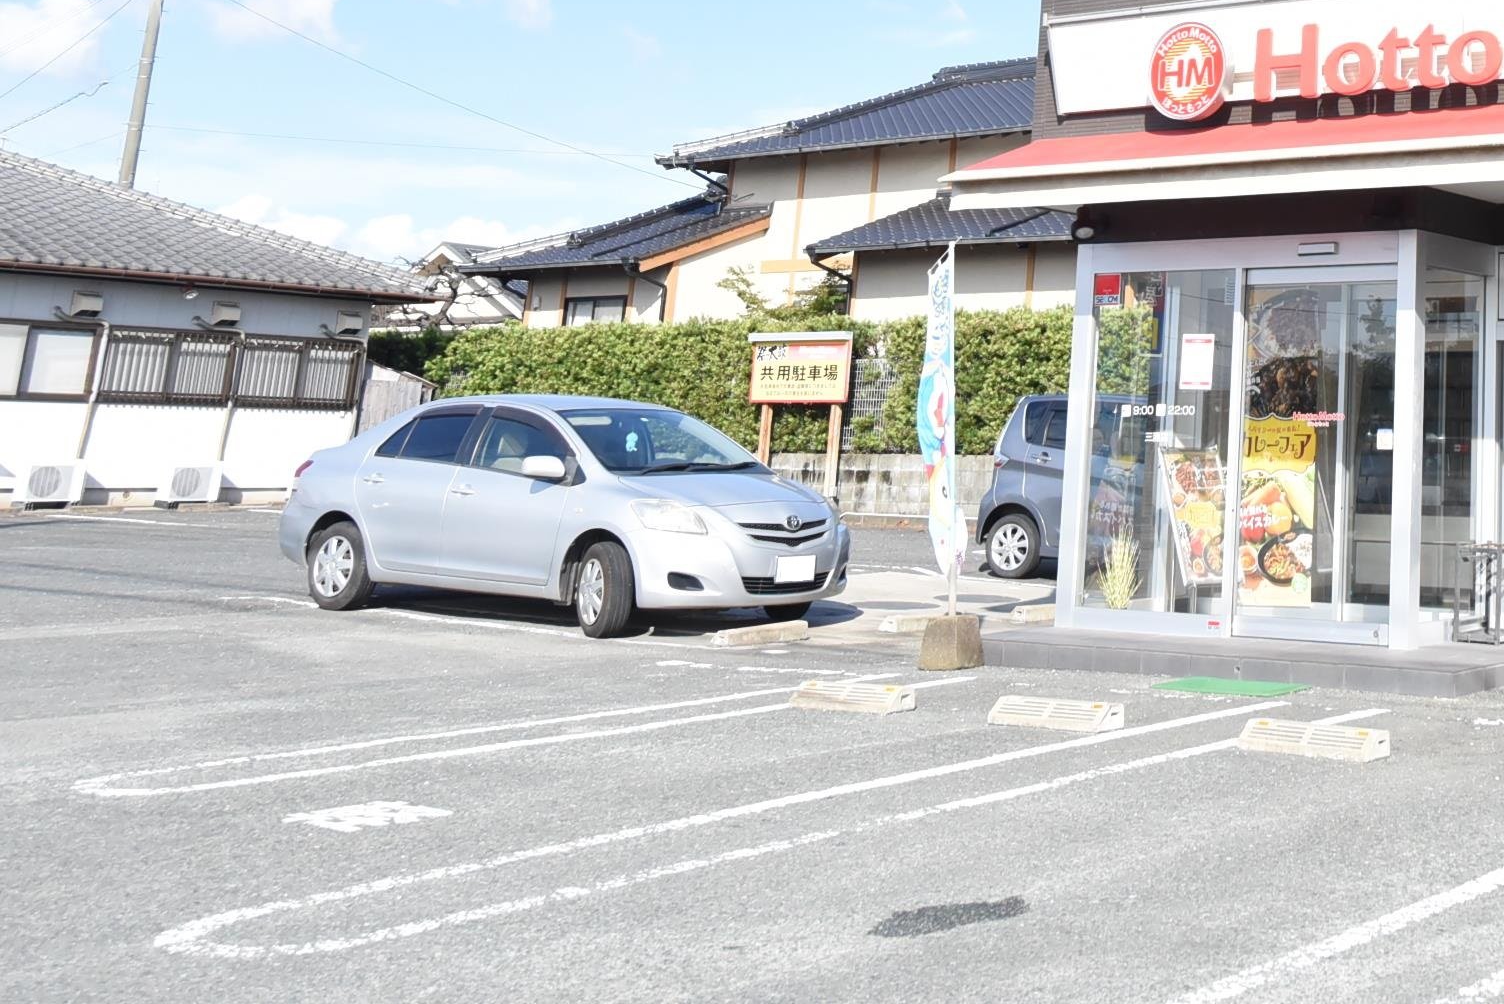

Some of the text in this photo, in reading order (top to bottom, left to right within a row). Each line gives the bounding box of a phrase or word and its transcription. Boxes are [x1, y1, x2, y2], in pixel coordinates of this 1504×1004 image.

[1160, 56, 1214, 89] HM
[760, 364, 838, 382] 共用駐車場
[1133, 405, 1154, 415] 9:00
[1167, 405, 1196, 416] 22:00
